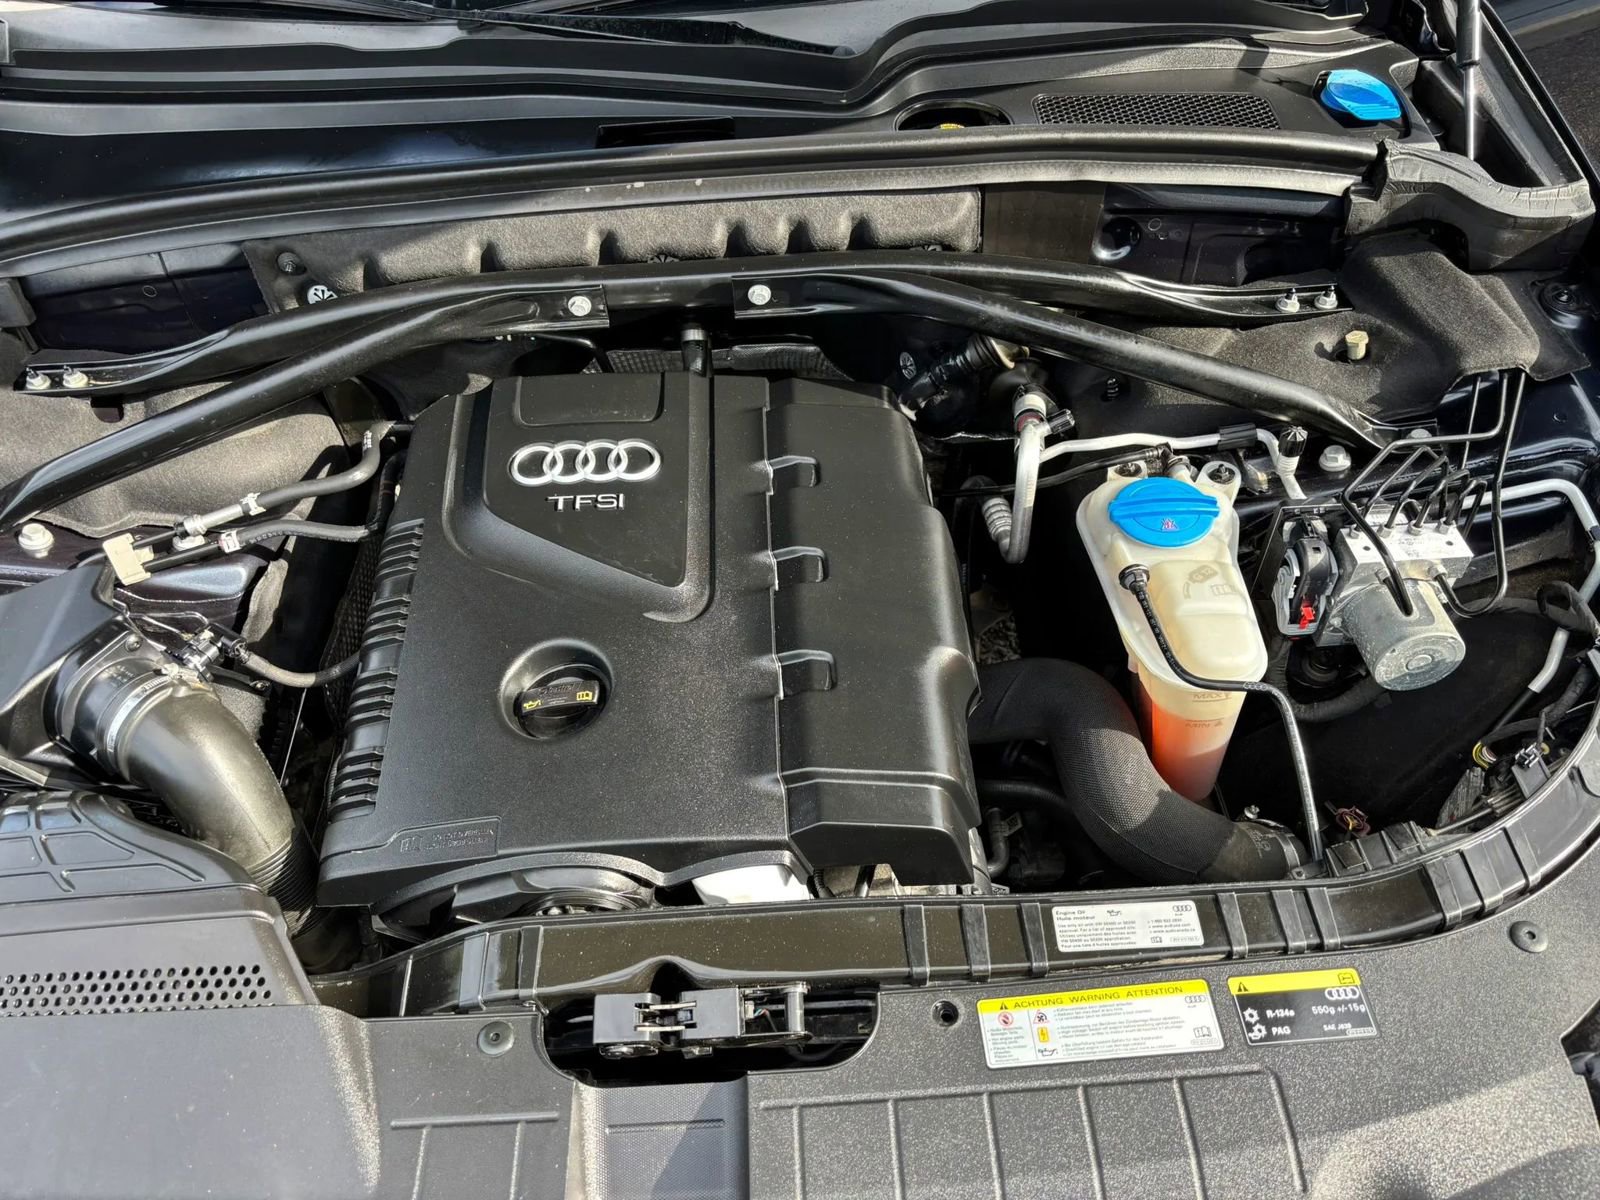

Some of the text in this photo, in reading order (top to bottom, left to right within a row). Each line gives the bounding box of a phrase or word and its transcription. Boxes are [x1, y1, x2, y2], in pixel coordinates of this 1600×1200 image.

[546, 493, 624, 511] TFSI
[1014, 986, 1183, 1009] ACHTUNG WARNING ATTENTION
[1266, 1009, 1295, 1019] R-134a
[1311, 1006, 1336, 1015] 550g
[1271, 1026, 1291, 1036] PAG
